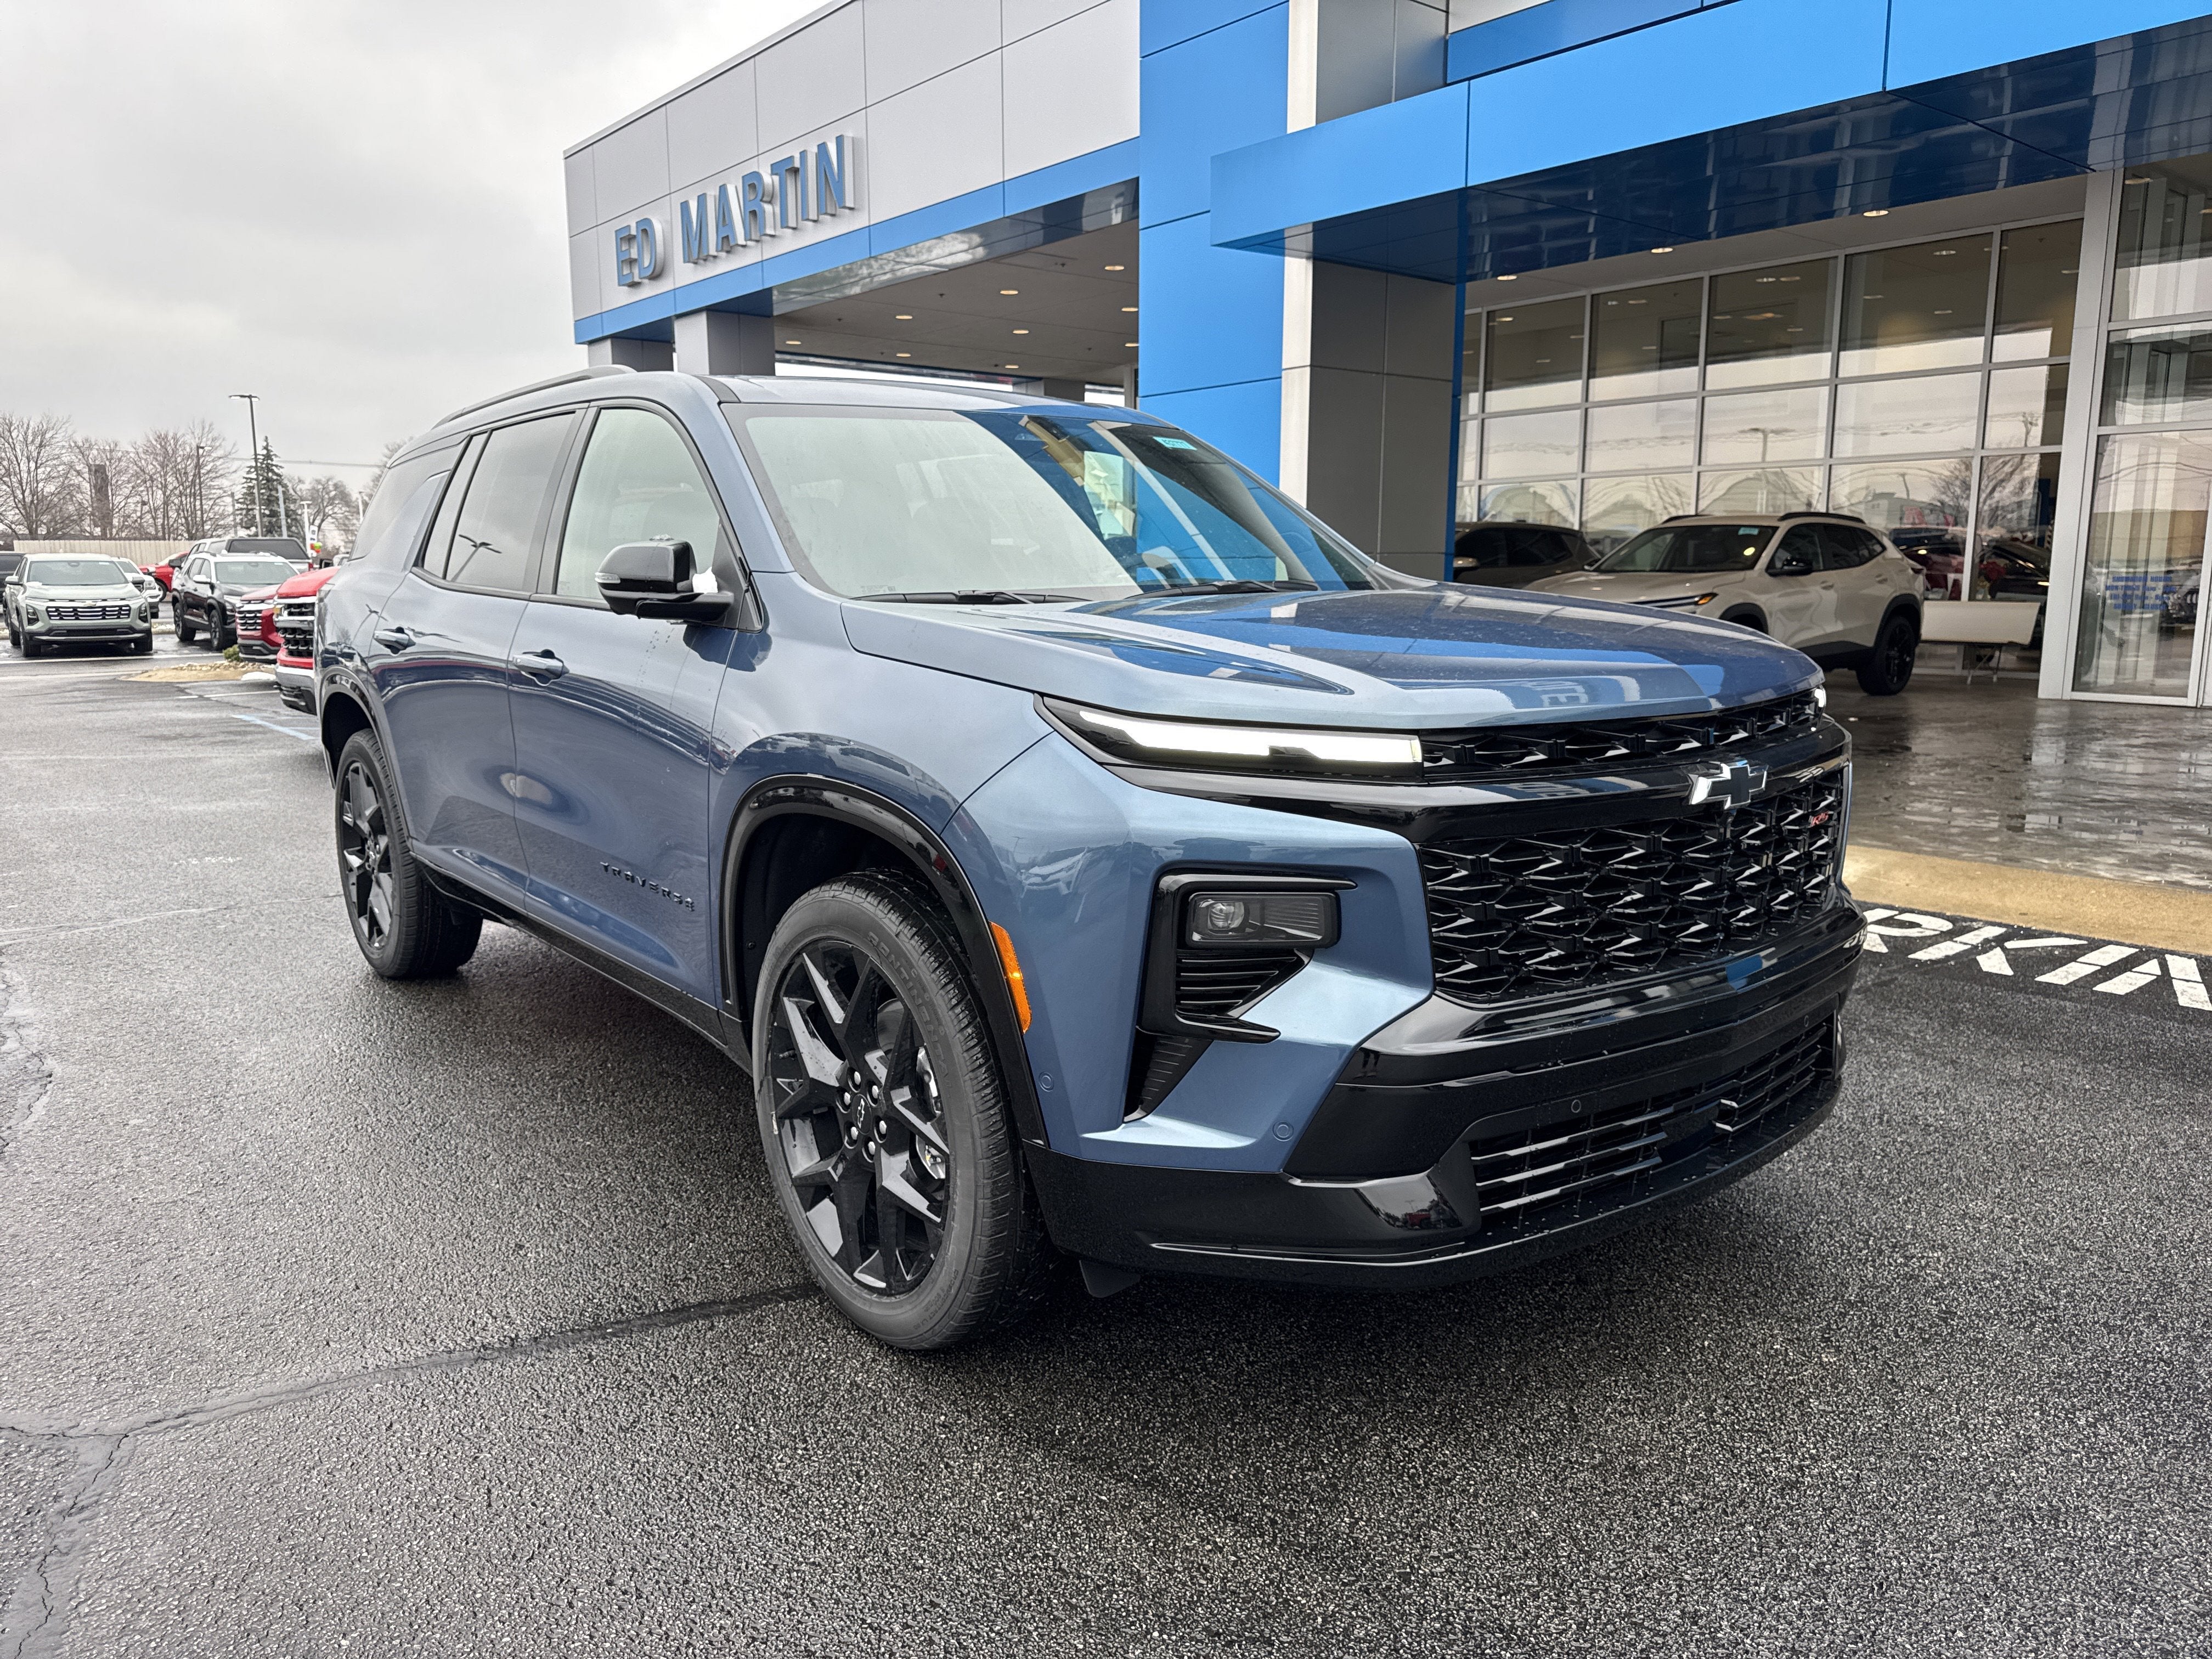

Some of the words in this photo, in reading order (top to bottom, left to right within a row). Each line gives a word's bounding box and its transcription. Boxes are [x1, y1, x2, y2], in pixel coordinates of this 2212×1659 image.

[614, 217, 663, 286] ED
[680, 134, 854, 264] MARTIN
[600, 861, 695, 912] TRAVERSE
[1863, 908, 2212, 1011] RKIN
